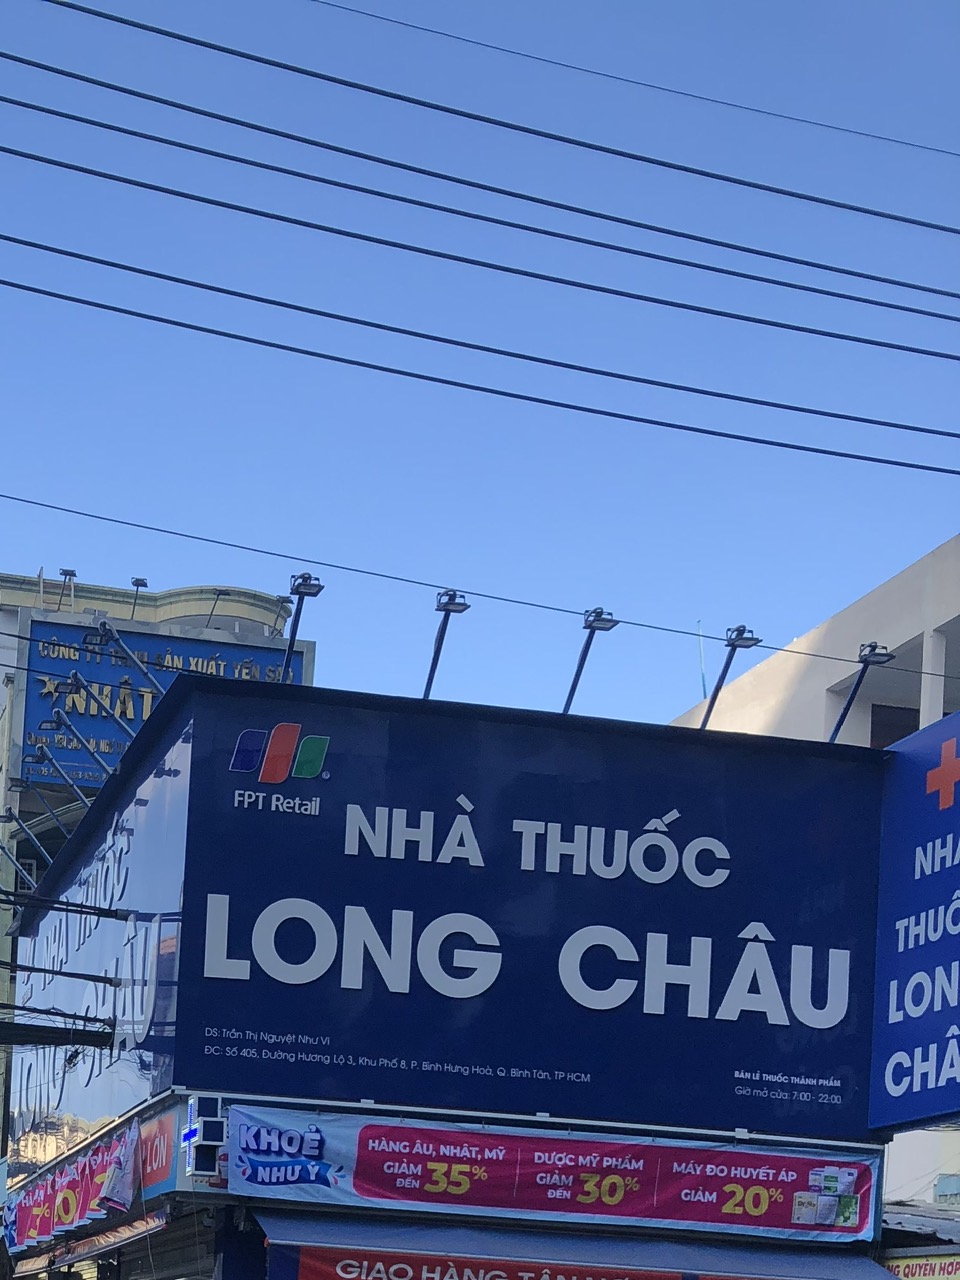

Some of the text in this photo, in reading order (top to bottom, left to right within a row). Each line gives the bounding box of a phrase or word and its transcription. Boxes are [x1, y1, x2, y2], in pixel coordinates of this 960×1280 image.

[234, 790, 320, 816] FPT Retail
[345, 794, 731, 888] NHÀ THUỐC
[204, 894, 850, 1028] LONG CHÂU
[205, 1027, 220, 1037] DS:
[260, 1032, 296, 1044] Nguyệt
[298, 1034, 319, 1045] Như
[204, 1045, 223, 1055] ĐC:
[225, 1046, 238, 1057] Số
[240, 1048, 260, 1059] 405,
[262, 1049, 296, 1062] Đường
[297, 1052, 330, 1065] Hương
[333, 1055, 345, 1066] Lộ
[358, 1056, 377, 1067] Khu
[378, 1058, 398, 1068] Phố
[410, 1061, 419, 1070] P.
[422, 1061, 442, 1071] Bình
[444, 1063, 470, 1076] Hưng
[510, 1067, 531, 1078] Bình
[554, 1071, 566, 1080] TP
[567, 1072, 590, 1083] HCM
[762, 1072, 789, 1083] THUỐC
[734, 1085, 751, 1096] Giờ
[752, 1087, 769, 1098] mở
[818, 1093, 842, 1104] 22:00
[239, 1123, 324, 1158] KHOẺ
[368, 1137, 410, 1154] HÀNG
[412, 1138, 437, 1157] ÂU,
[484, 1145, 506, 1161] MỸ
[383, 1159, 423, 1176] GIẢM
[534, 1150, 644, 1171] DƯỢC MỸ PHẨM
[257, 1165, 302, 1183] NHƯ
[396, 1174, 420, 1189] ĐẾN
[423, 1162, 489, 1195] 35%
[536, 1171, 574, 1187] GIẢM
[672, 1161, 797, 1183] MÁY ĐO HUYẾT ÁP
[547, 1185, 572, 1200] ĐẾN
[576, 1173, 640, 1206] 30%
[681, 1186, 717, 1204] GIẢM
[721, 1183, 784, 1217] 20%
